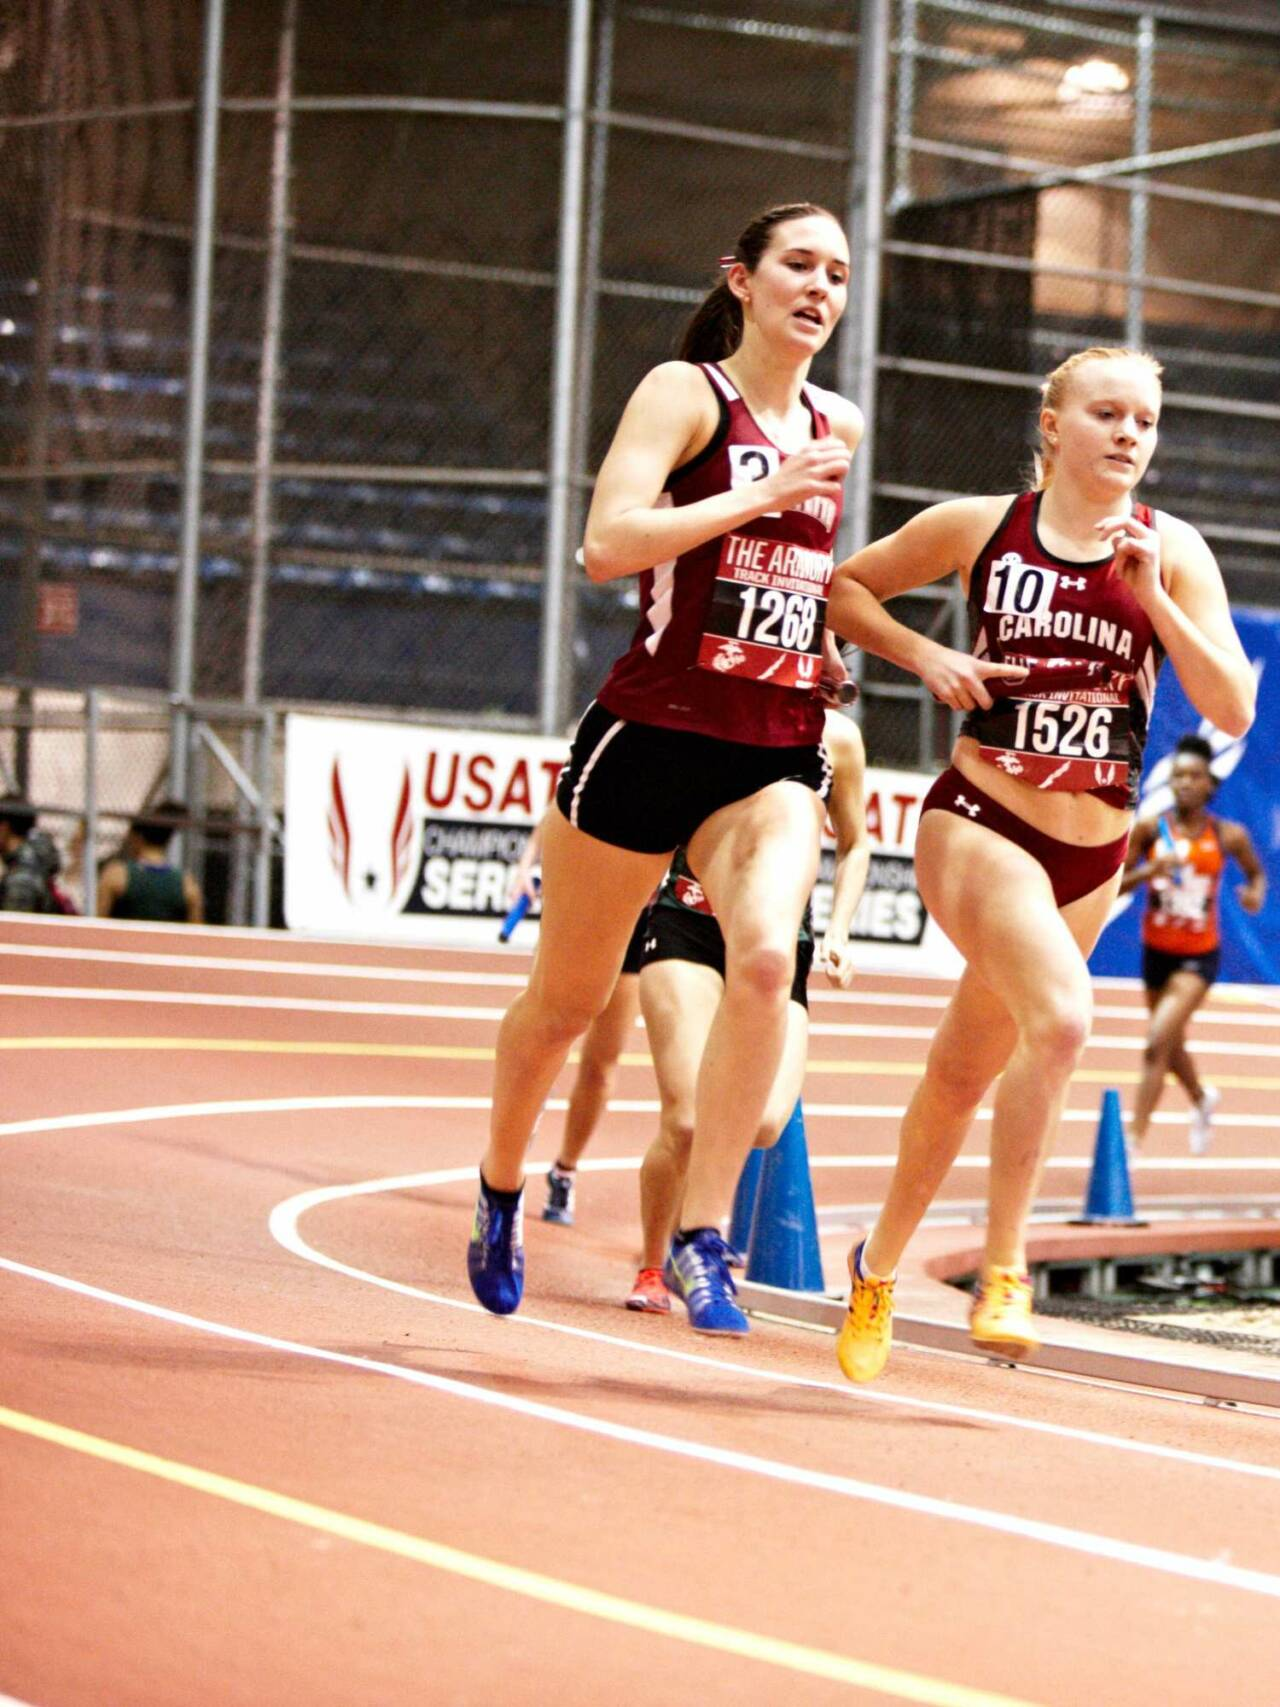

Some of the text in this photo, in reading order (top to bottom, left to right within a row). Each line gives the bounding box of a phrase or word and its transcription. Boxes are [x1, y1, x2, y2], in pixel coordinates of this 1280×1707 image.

[726, 535, 835, 585] THE ARMORY
[734, 566, 770, 586] TRACK
[994, 564, 1045, 614] 10
[737, 586, 818, 651] 1268
[997, 610, 1133, 661] CAROLINA
[1049, 690, 1121, 704] INVITATIONAL
[1014, 701, 1113, 759] 1526
